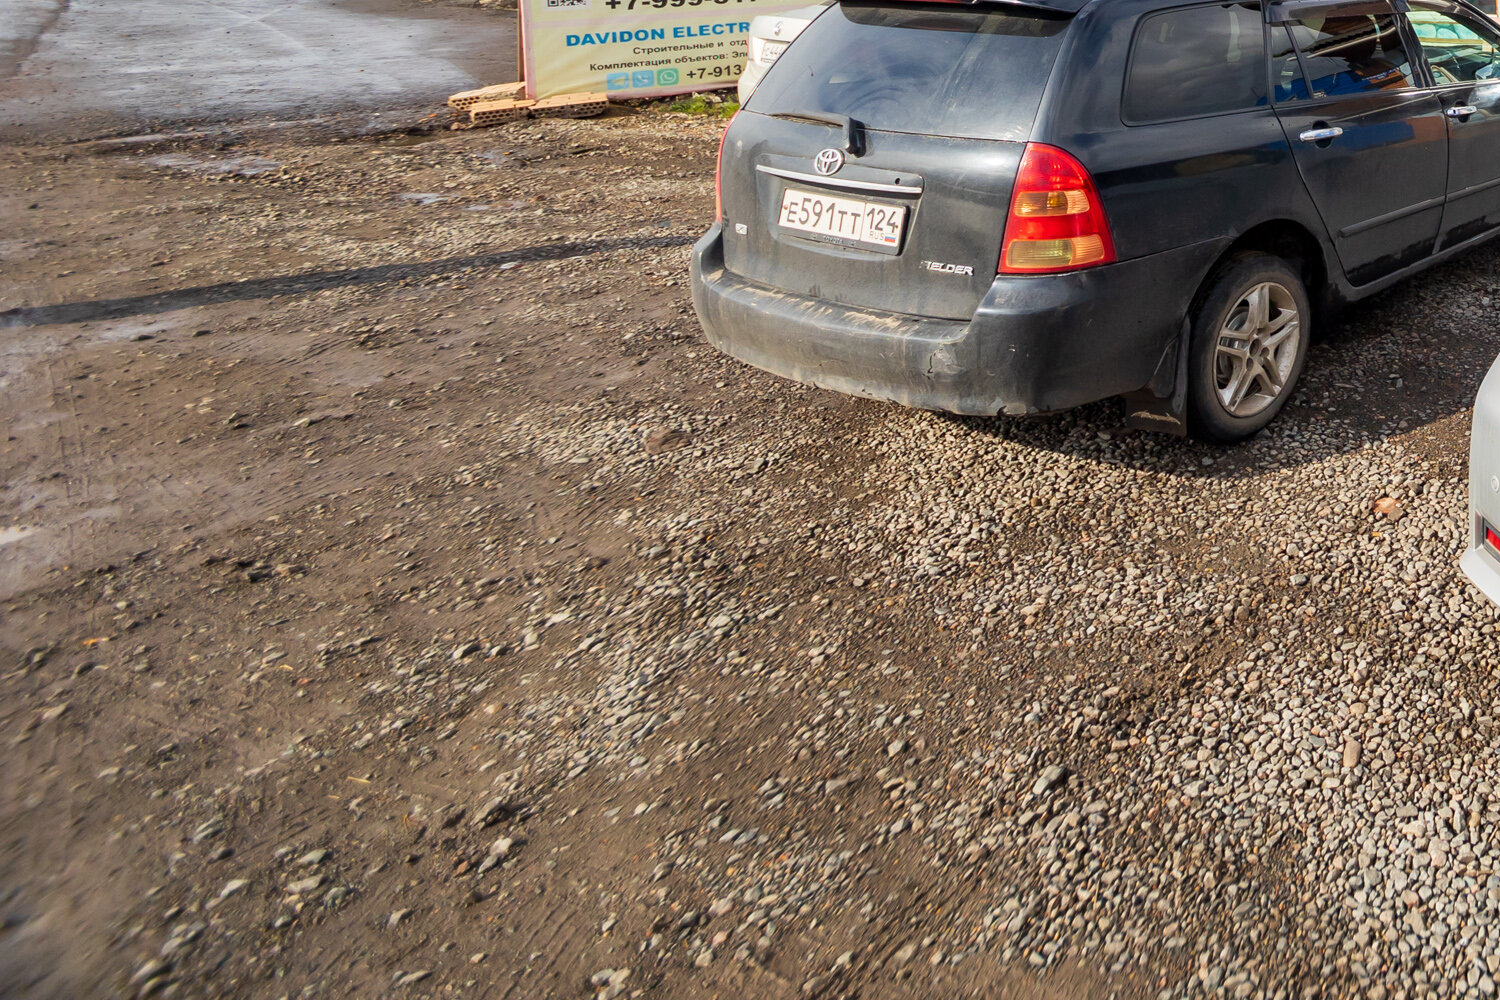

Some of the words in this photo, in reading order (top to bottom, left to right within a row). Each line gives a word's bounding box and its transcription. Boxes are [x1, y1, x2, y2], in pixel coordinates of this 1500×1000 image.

[566, 28, 665, 47] DAVIDON
[633, 41, 714, 55] Строительные
[590, 58, 672, 72] Комплектация
[675, 52, 729, 64] объектов:
[866, 207, 898, 234] 124
[869, 231, 885, 241] RUS
